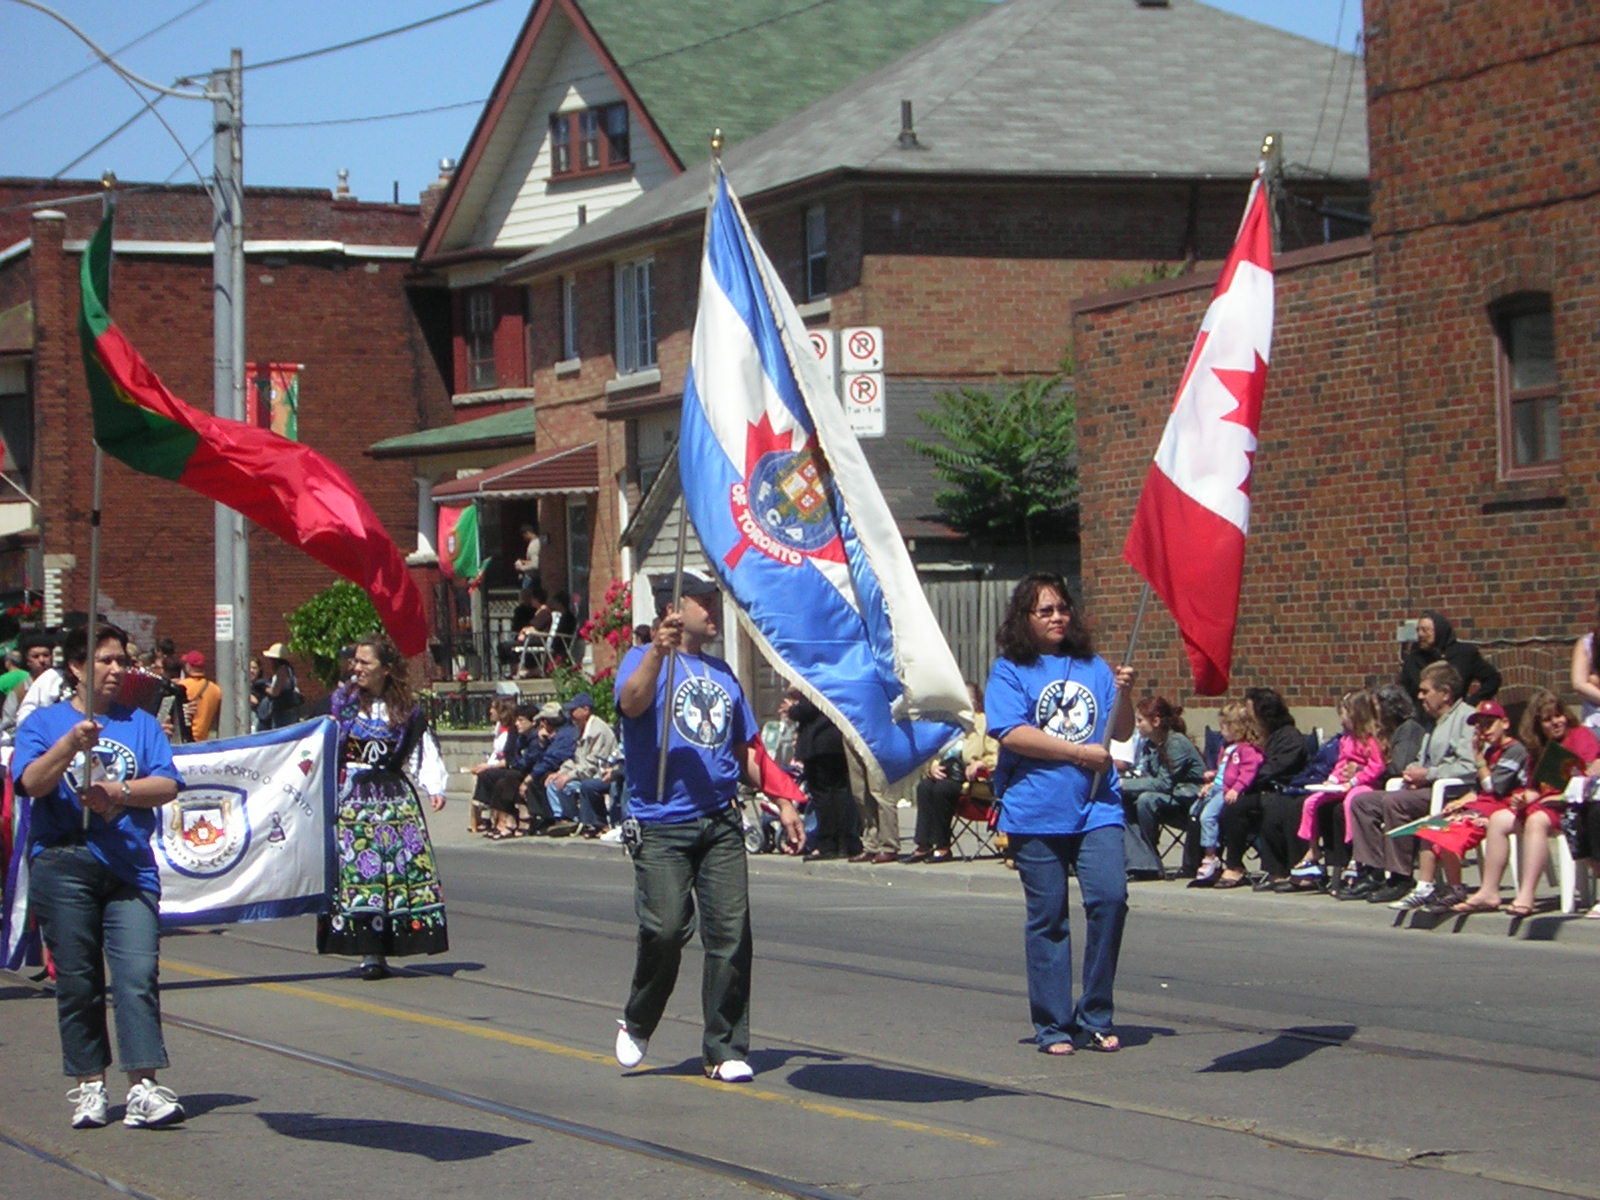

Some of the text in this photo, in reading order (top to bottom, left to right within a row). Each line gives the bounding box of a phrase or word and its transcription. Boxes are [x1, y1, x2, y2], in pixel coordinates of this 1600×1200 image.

[732, 484, 803, 565] OF TORONTO
[224, 764, 259, 781] PORTO
